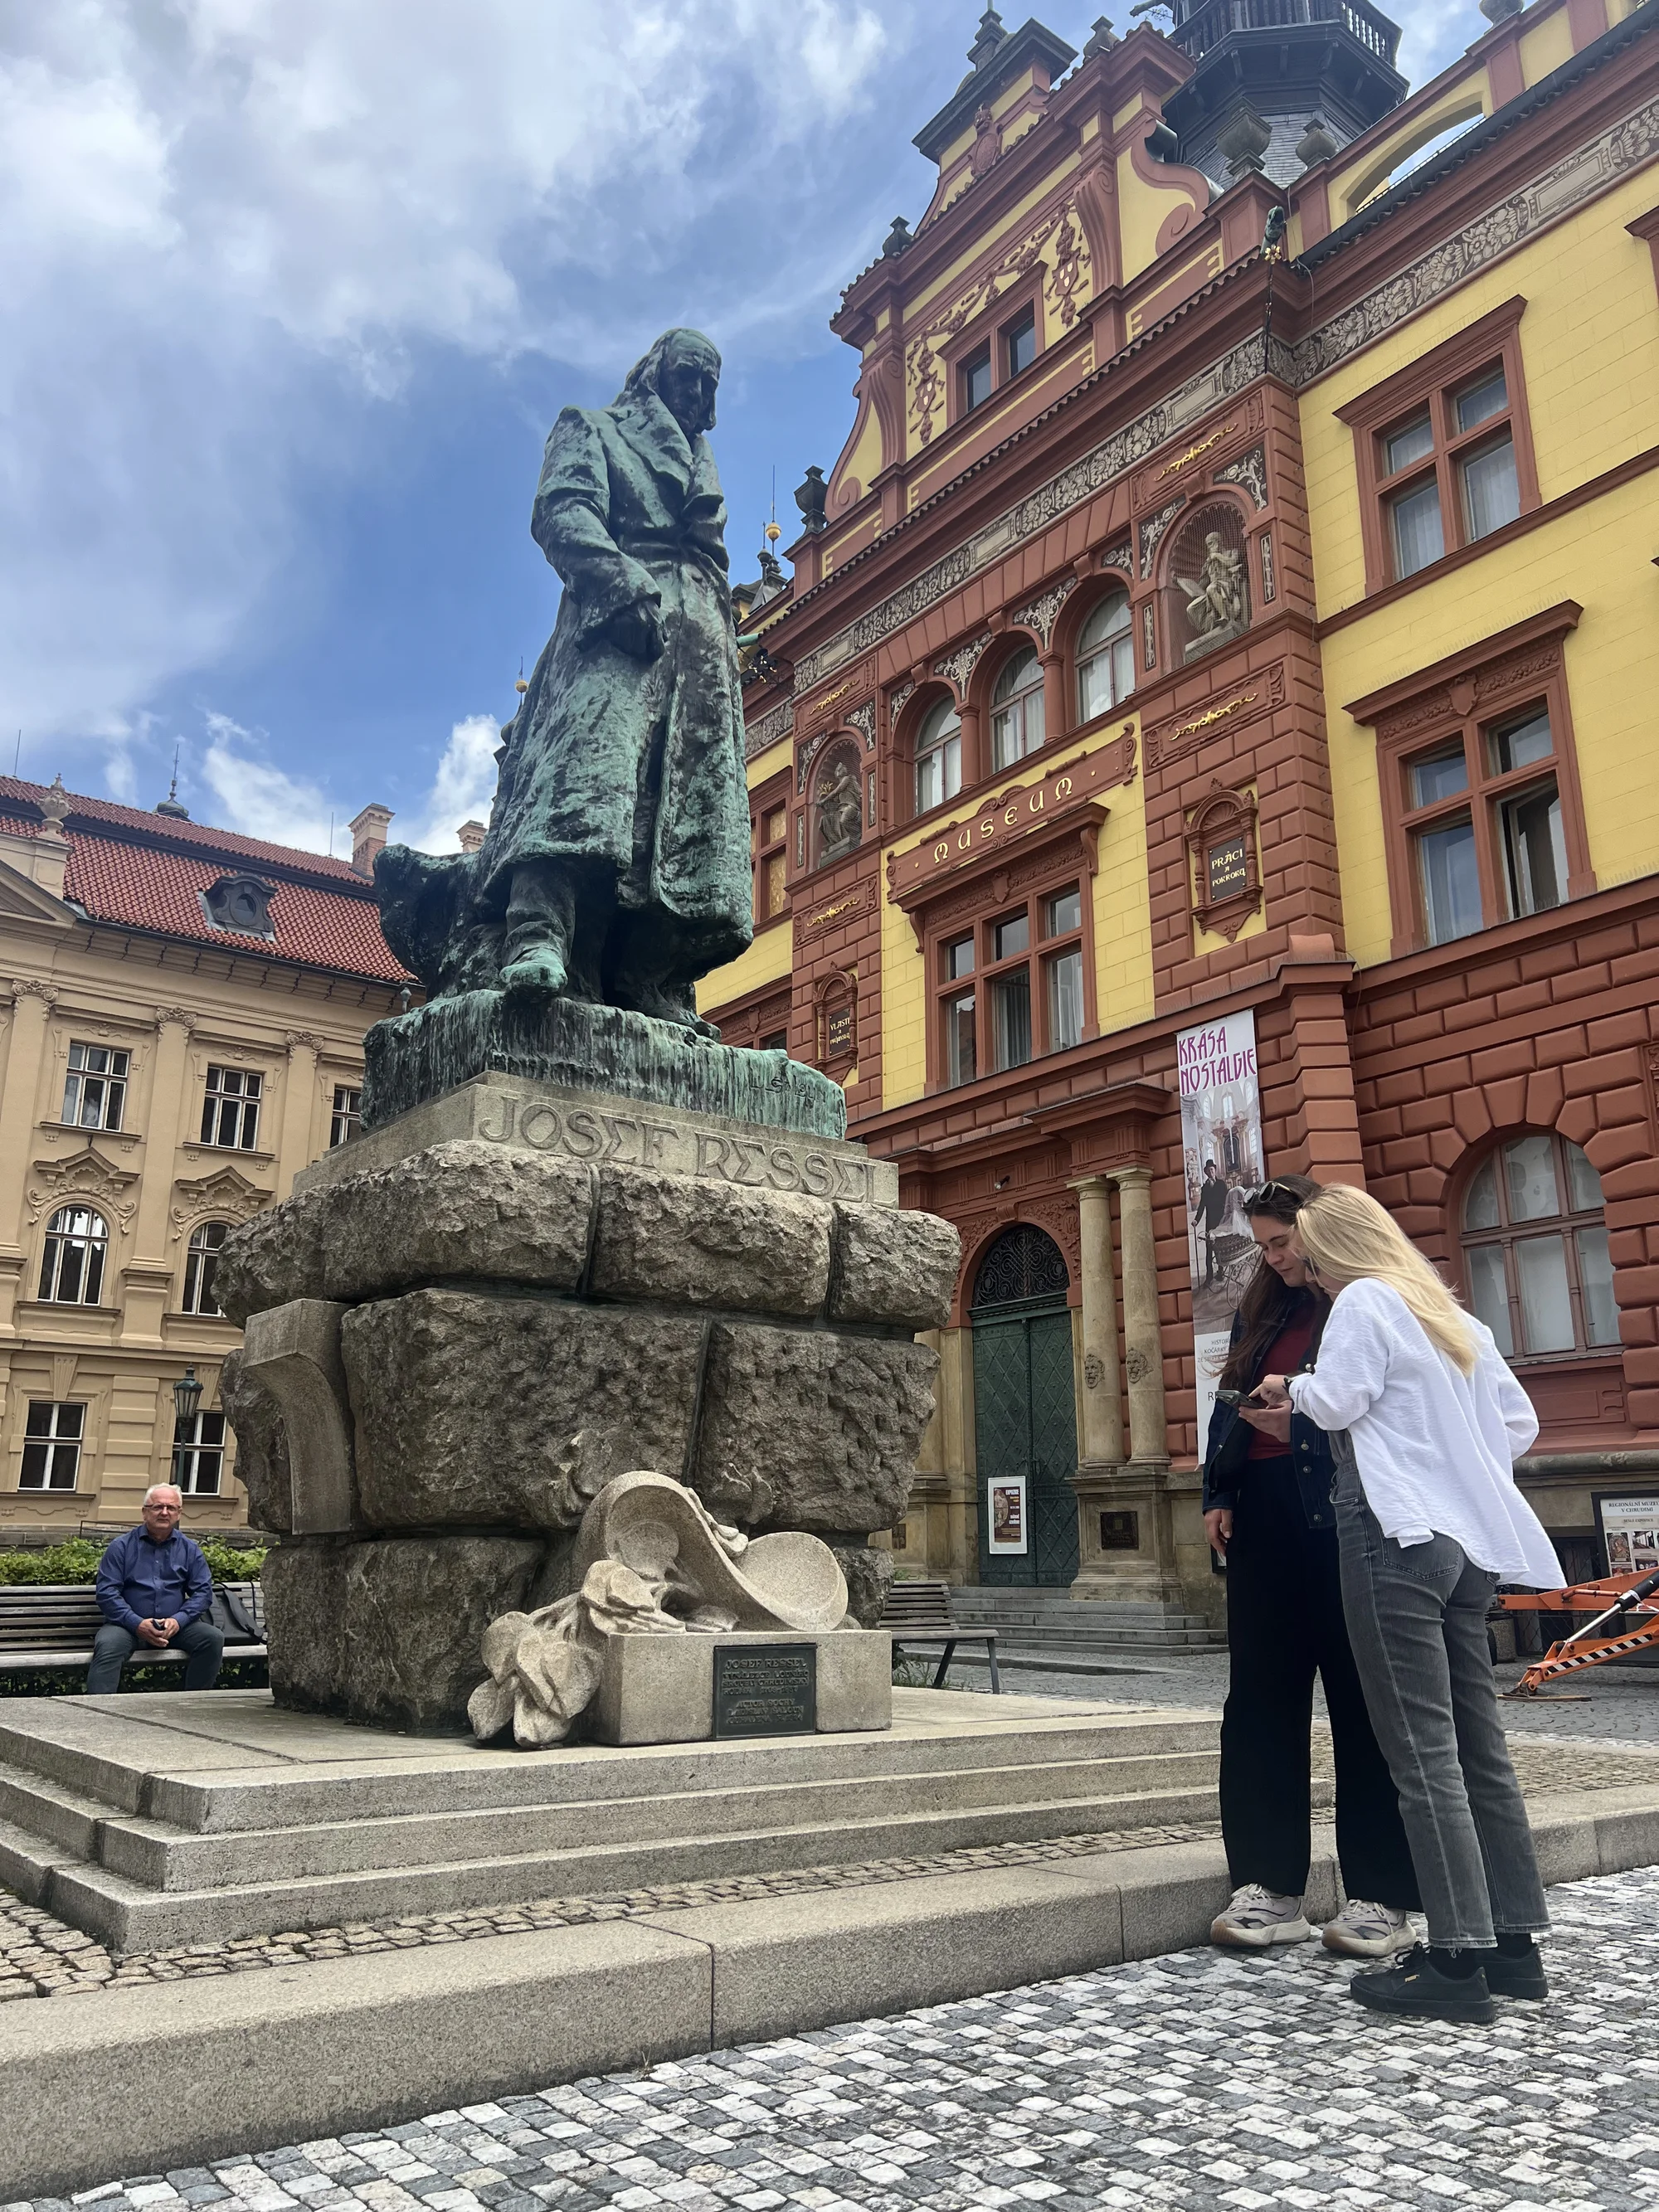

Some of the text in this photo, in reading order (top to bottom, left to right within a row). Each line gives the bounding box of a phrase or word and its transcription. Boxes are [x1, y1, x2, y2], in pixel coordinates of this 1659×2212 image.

[933, 776, 1073, 864] MUSEUM
[1211, 848, 1243, 870] PRÁCI
[830, 1017, 850, 1031] VLASTI
[1178, 1026, 1228, 1067] KRÁSA
[1180, 1048, 1257, 1096] NOSTALGIE
[479, 1094, 898, 1208] JOSEF RESSEL
[724, 1657, 807, 1670] JOSEF RESSEL
